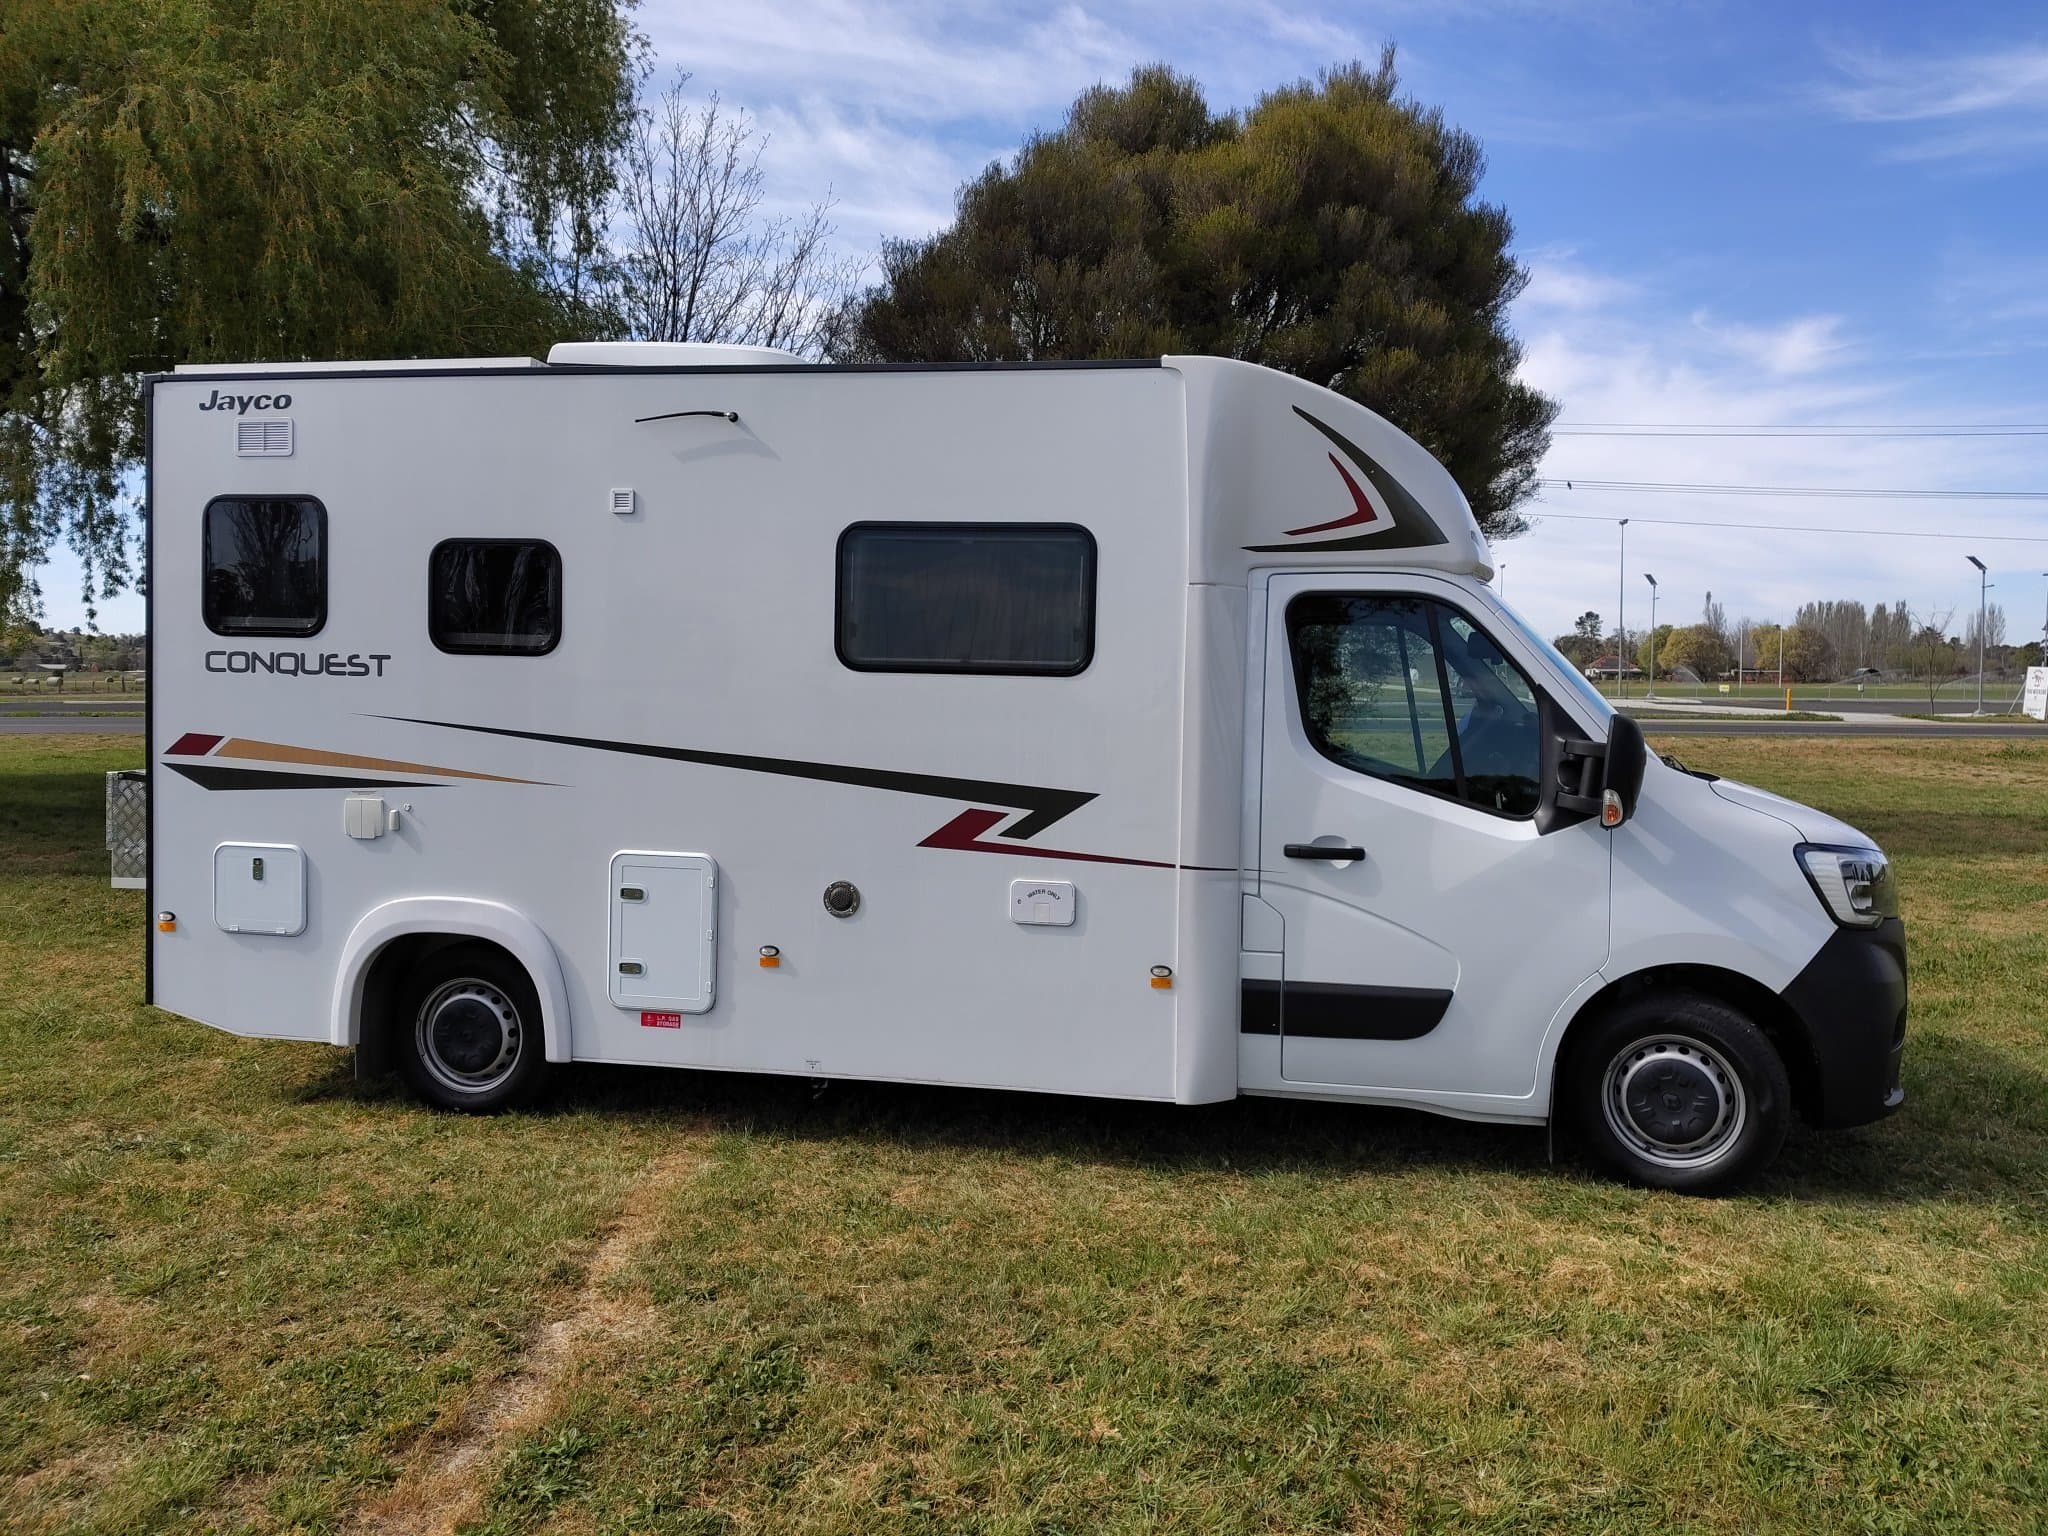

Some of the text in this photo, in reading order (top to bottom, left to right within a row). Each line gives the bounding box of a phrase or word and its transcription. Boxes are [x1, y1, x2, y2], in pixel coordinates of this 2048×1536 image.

[199, 390, 293, 415] Jayco
[205, 651, 392, 677] CONQUEST
[1026, 889, 1046, 898] WATER
